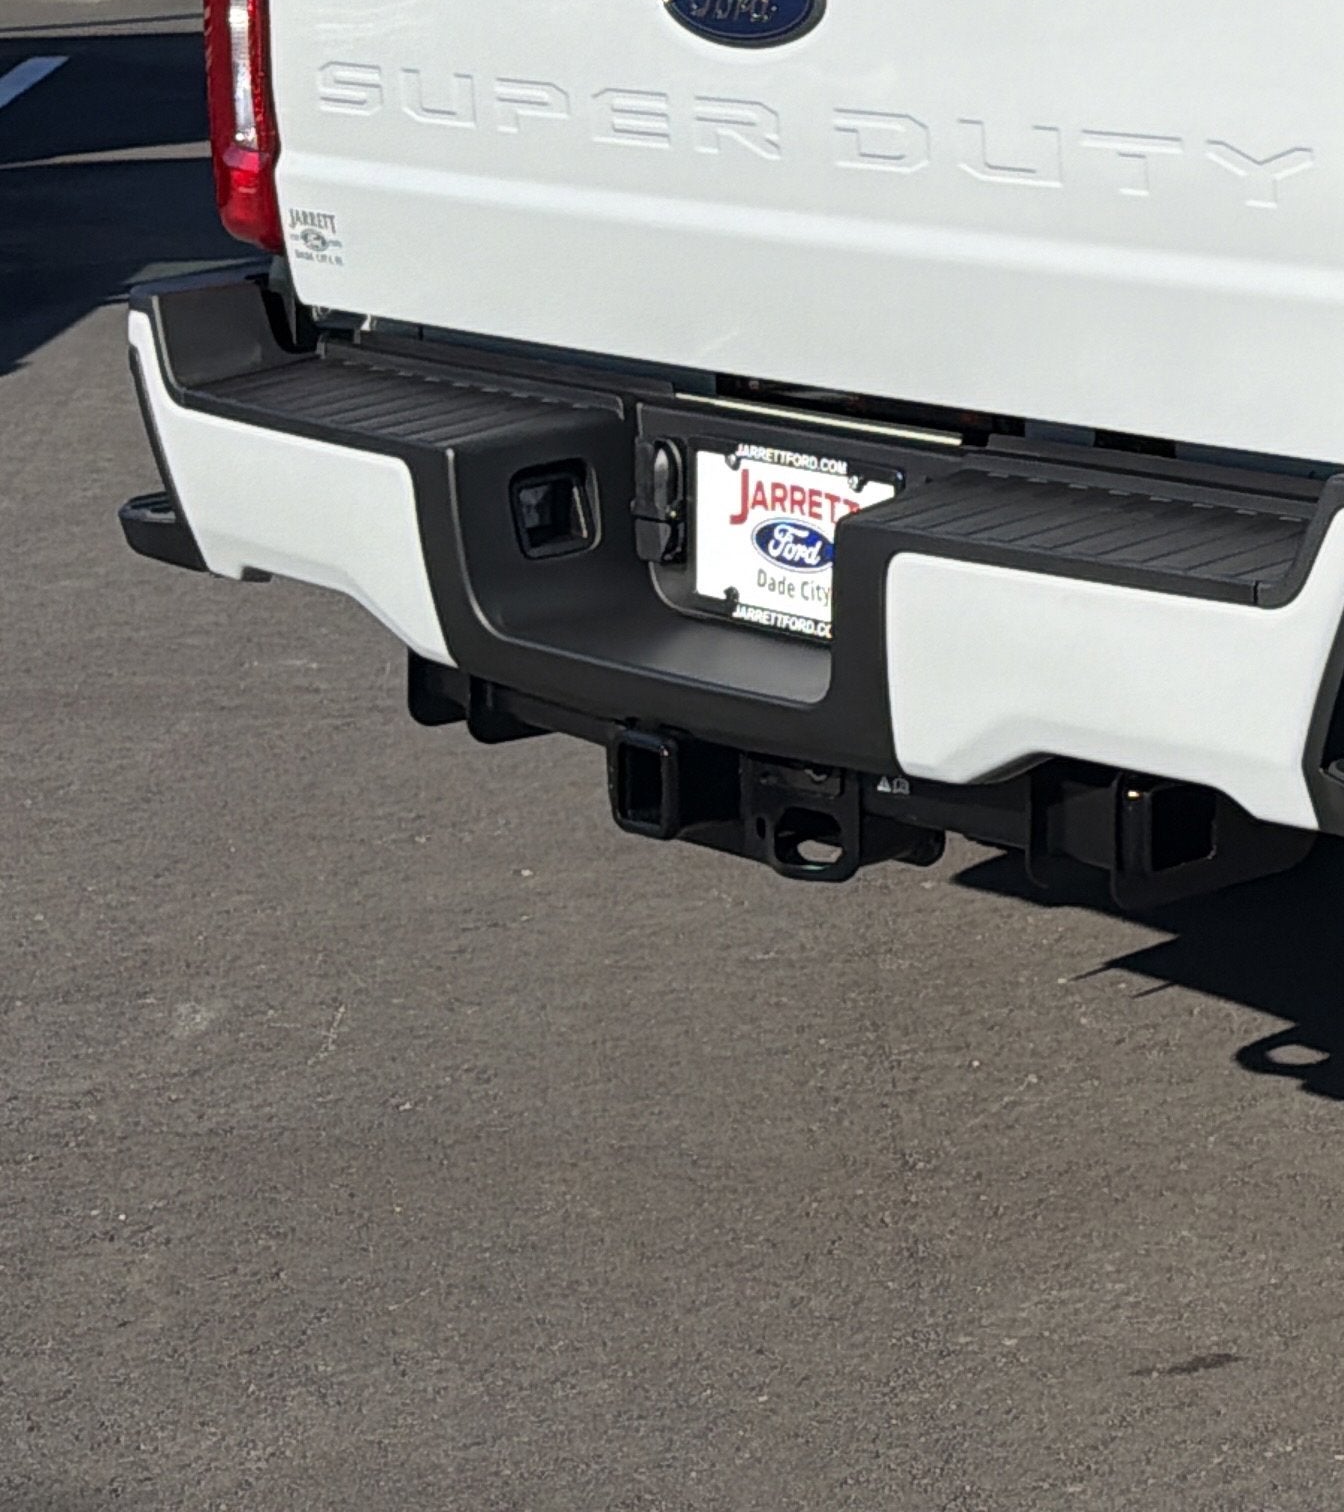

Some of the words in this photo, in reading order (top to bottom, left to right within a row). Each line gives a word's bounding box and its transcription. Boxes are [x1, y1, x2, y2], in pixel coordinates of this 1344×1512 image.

[318, 60, 781, 162] SUPER
[832, 106, 1314, 209] DUTY
[735, 443, 848, 475] JARRETTFORD.COM
[767, 523, 823, 566] Ford
[756, 568, 796, 599] Dade
[800, 579, 832, 607] City
